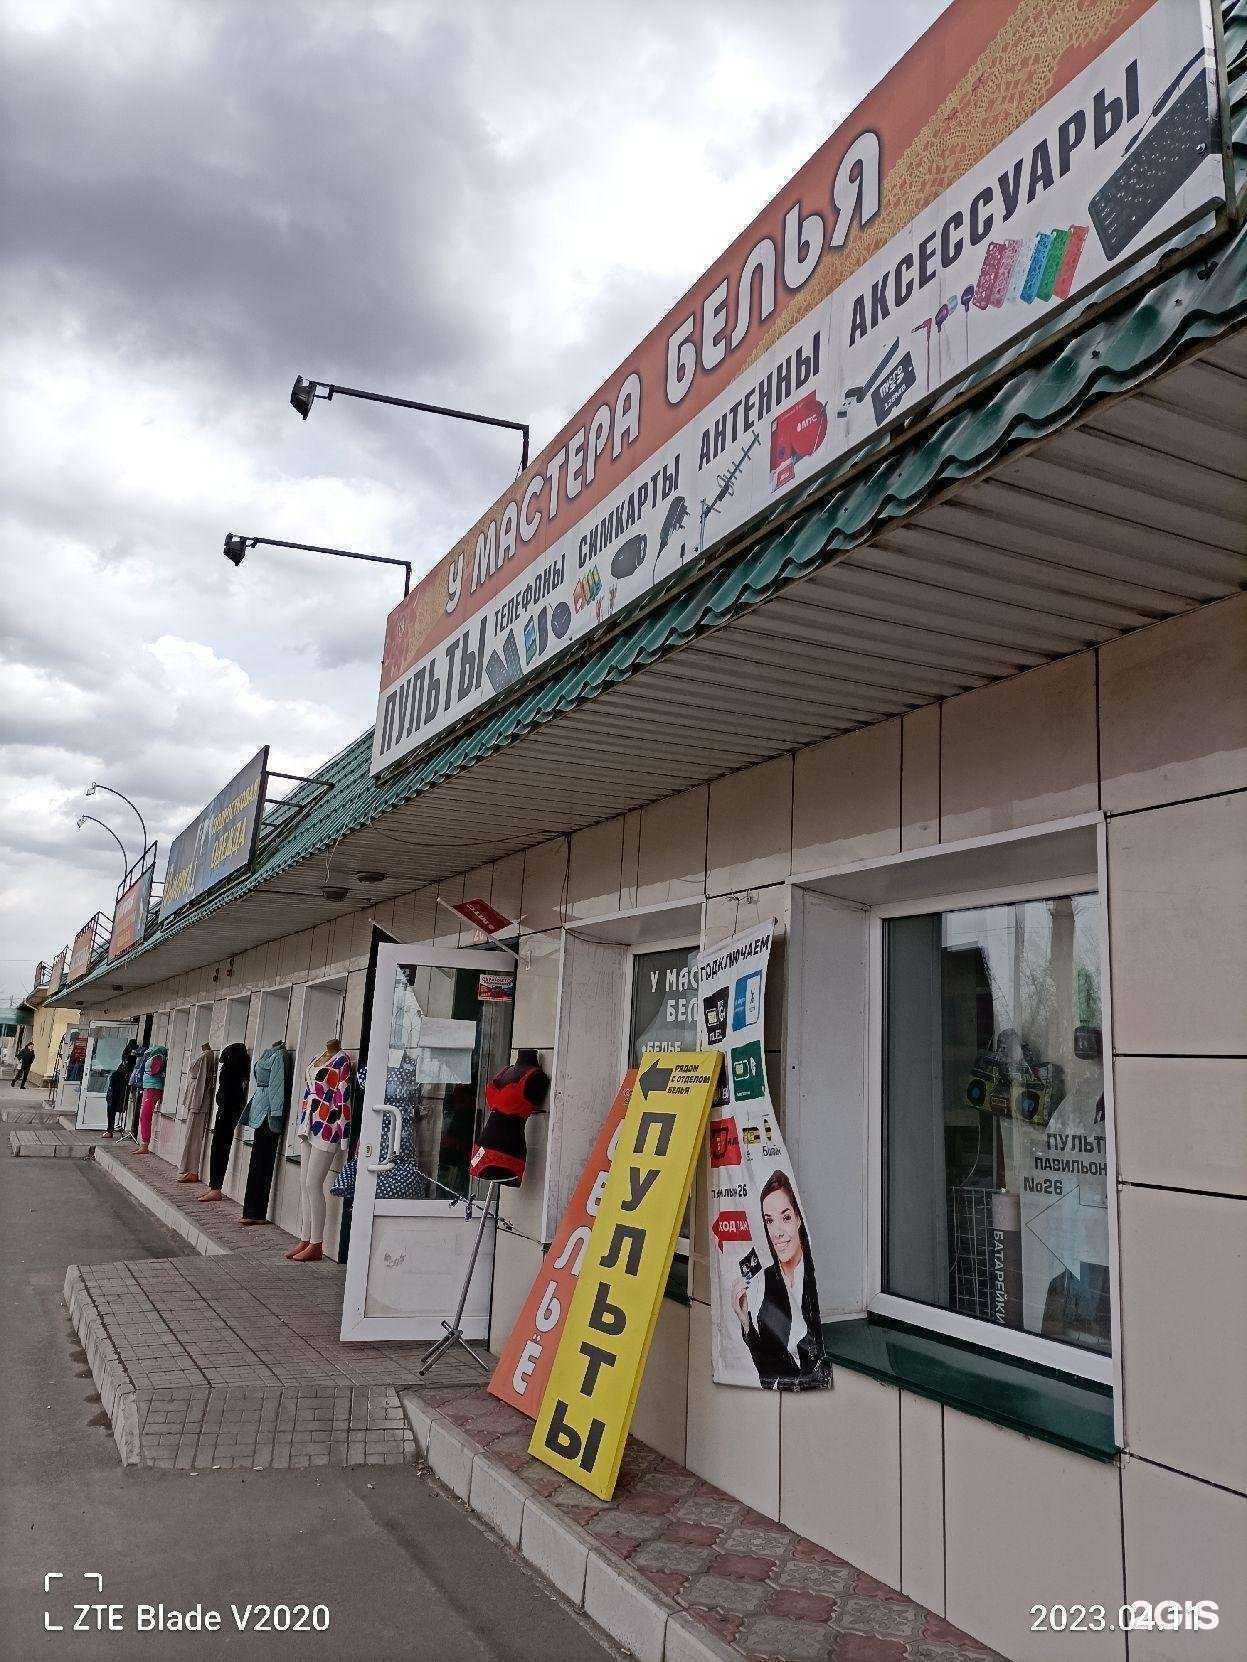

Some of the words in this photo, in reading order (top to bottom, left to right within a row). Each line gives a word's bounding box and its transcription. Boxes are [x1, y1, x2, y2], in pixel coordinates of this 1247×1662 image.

[445, 553, 464, 614] У
[470, 373, 641, 595] МАСТЕРА
[666, 131, 880, 405] БЕЛЬЯ
[380, 615, 487, 755] ПУЛЬТЫ
[494, 553, 566, 636] ТЕЛЕФОНЫ
[578, 453, 681, 569] СИМКАРТЫ
[698, 331, 821, 472] АНТЕННЫ
[849, 59, 1140, 348] АКСЕССУАРЫ
[650, 970, 660, 993] У
[674, 1064, 700, 1073] РЯДОМ
[676, 1075, 711, 1084] ОТДЕЛОМ
[667, 1086, 691, 1095] БЕЛЬЯ
[1046, 1132, 1107, 1155] ПУЛЬТ
[1034, 1156, 1108, 1176] ПАВИЛЬОН
[544, 1111, 677, 1474] ПУЛЬТЫ
